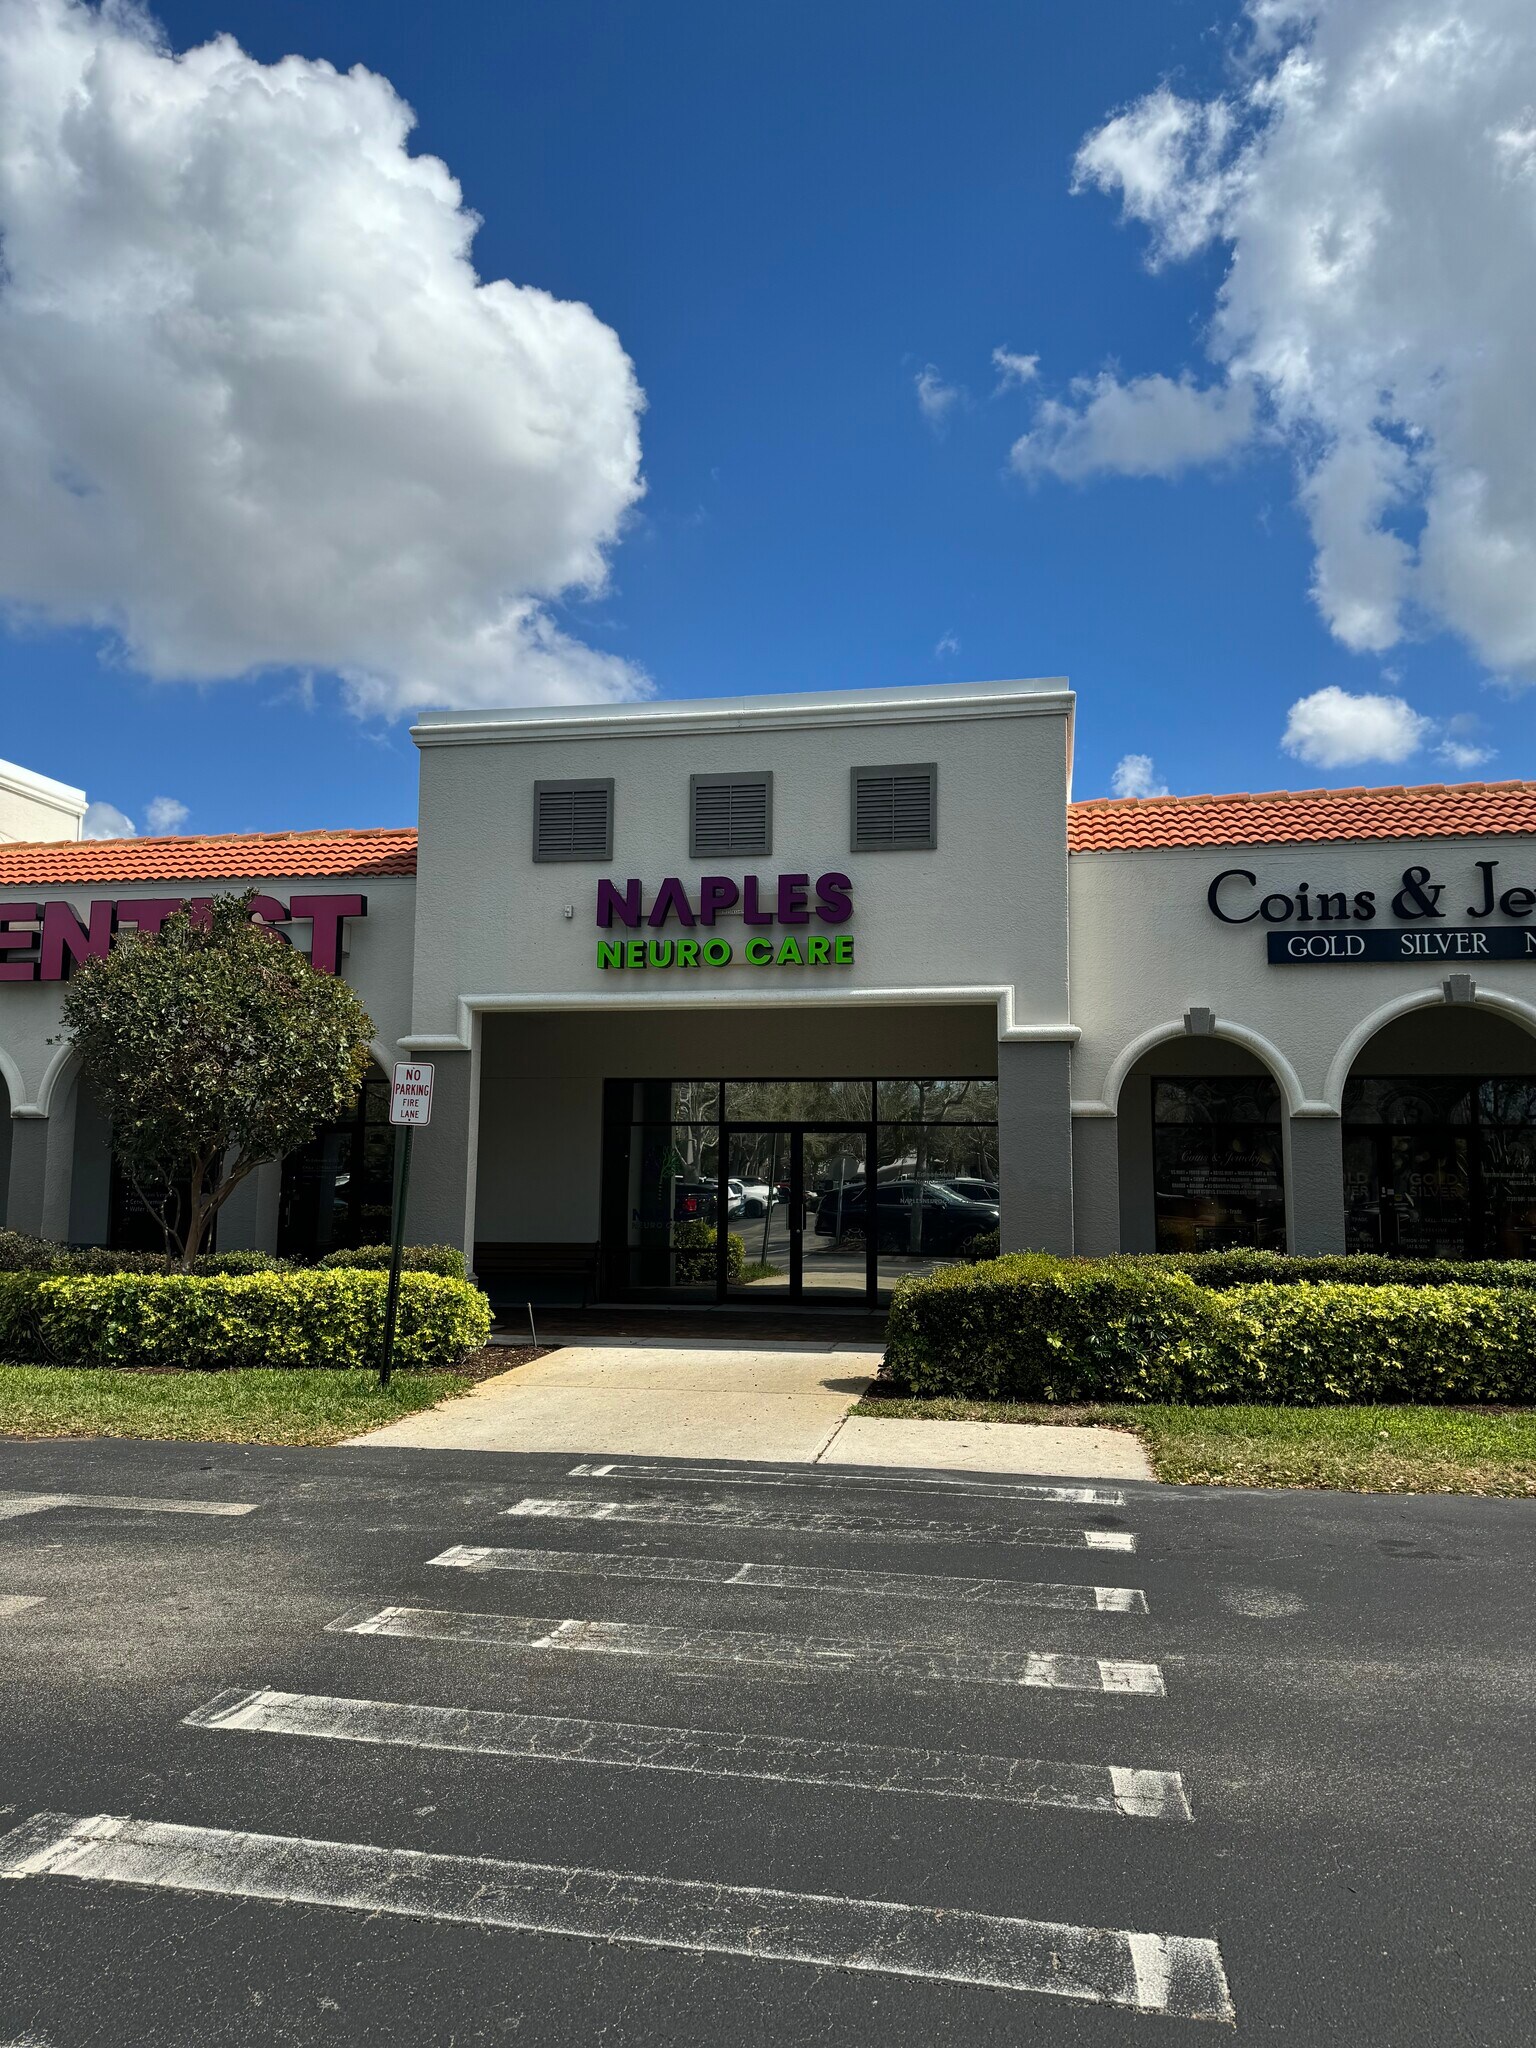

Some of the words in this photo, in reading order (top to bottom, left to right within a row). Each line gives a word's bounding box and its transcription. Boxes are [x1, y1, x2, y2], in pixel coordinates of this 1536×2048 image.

[596, 871, 855, 928] NAPLES
[1207, 868, 1377, 924] Coins
[1390, 865, 1447, 920] &
[1466, 860, 1536, 918] Je
[596, 937, 733, 970] NEURO
[744, 934, 856, 966] CARE
[1286, 935, 1366, 957] GOLD
[1399, 932, 1490, 955] SILVER
[405, 1069, 421, 1081] NO
[395, 1083, 429, 1096] PARKING
[402, 1098, 420, 1107] FIRE
[400, 1109, 420, 1119] LANE
